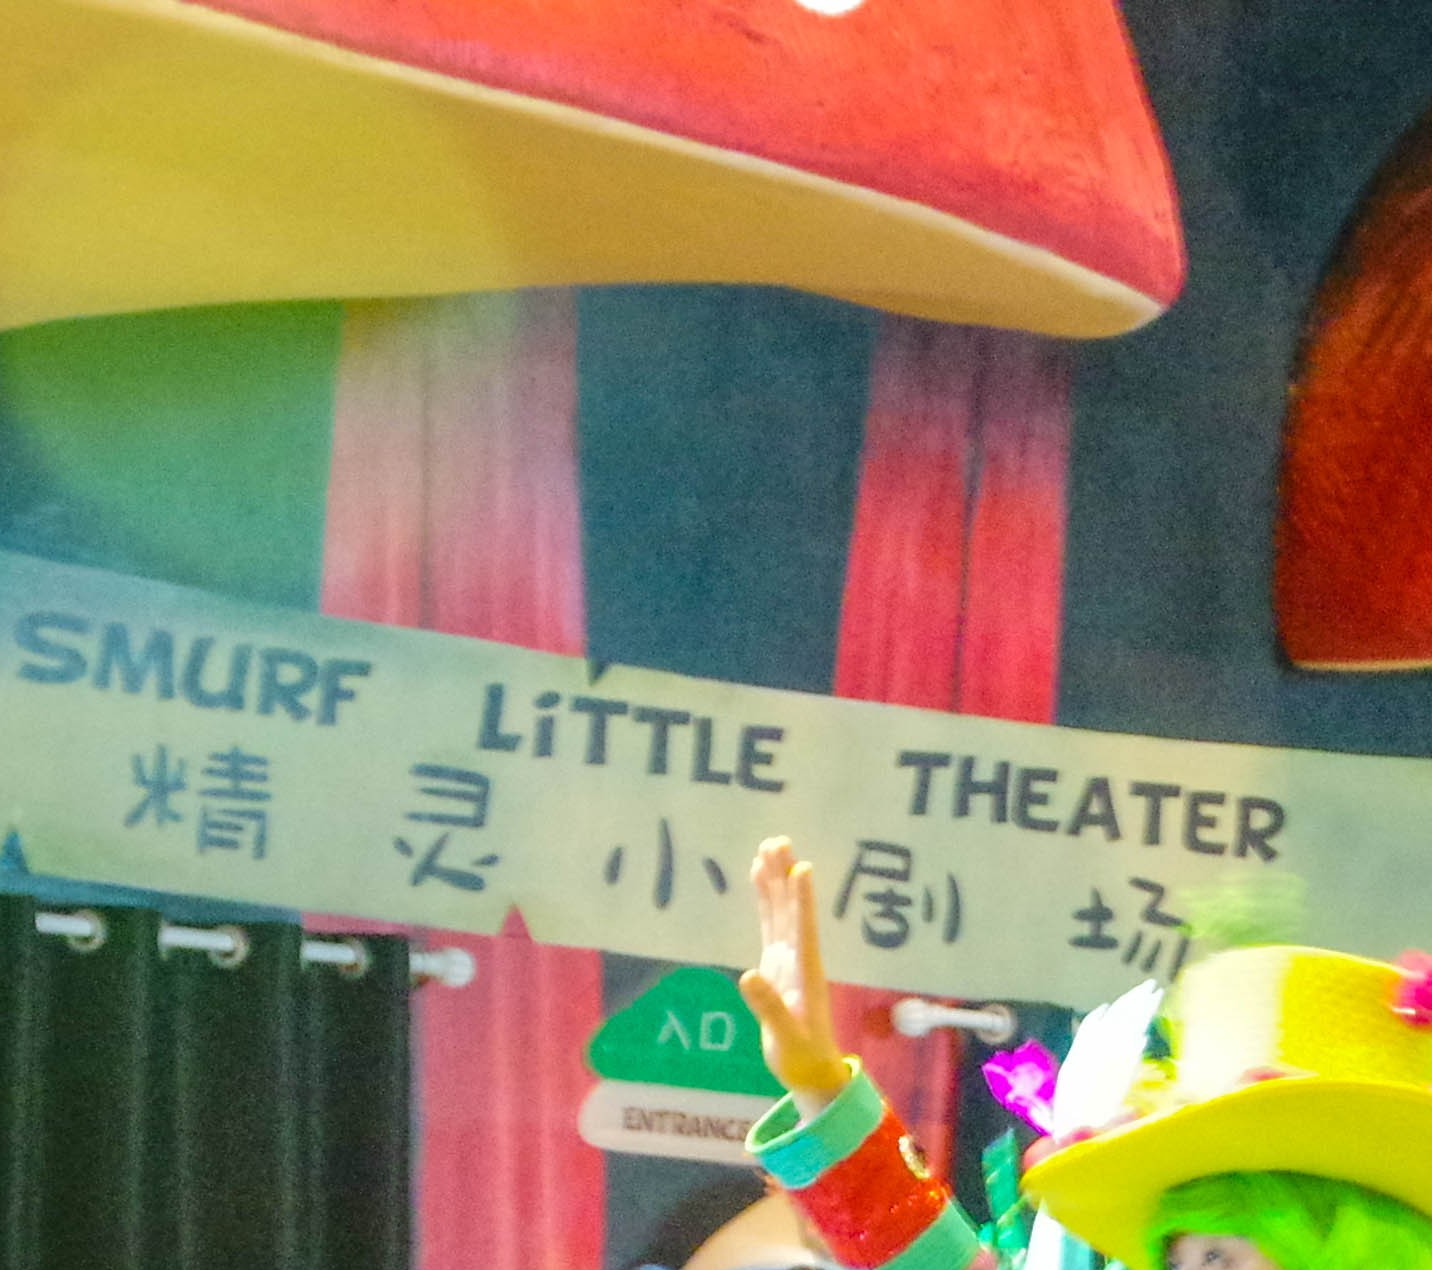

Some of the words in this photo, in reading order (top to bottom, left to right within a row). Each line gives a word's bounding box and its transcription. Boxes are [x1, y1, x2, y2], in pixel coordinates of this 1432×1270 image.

[15, 610, 372, 726] SMURF
[896, 749, 1286, 863] THEATER
[123, 742, 1192, 984] 精灵小剧场
